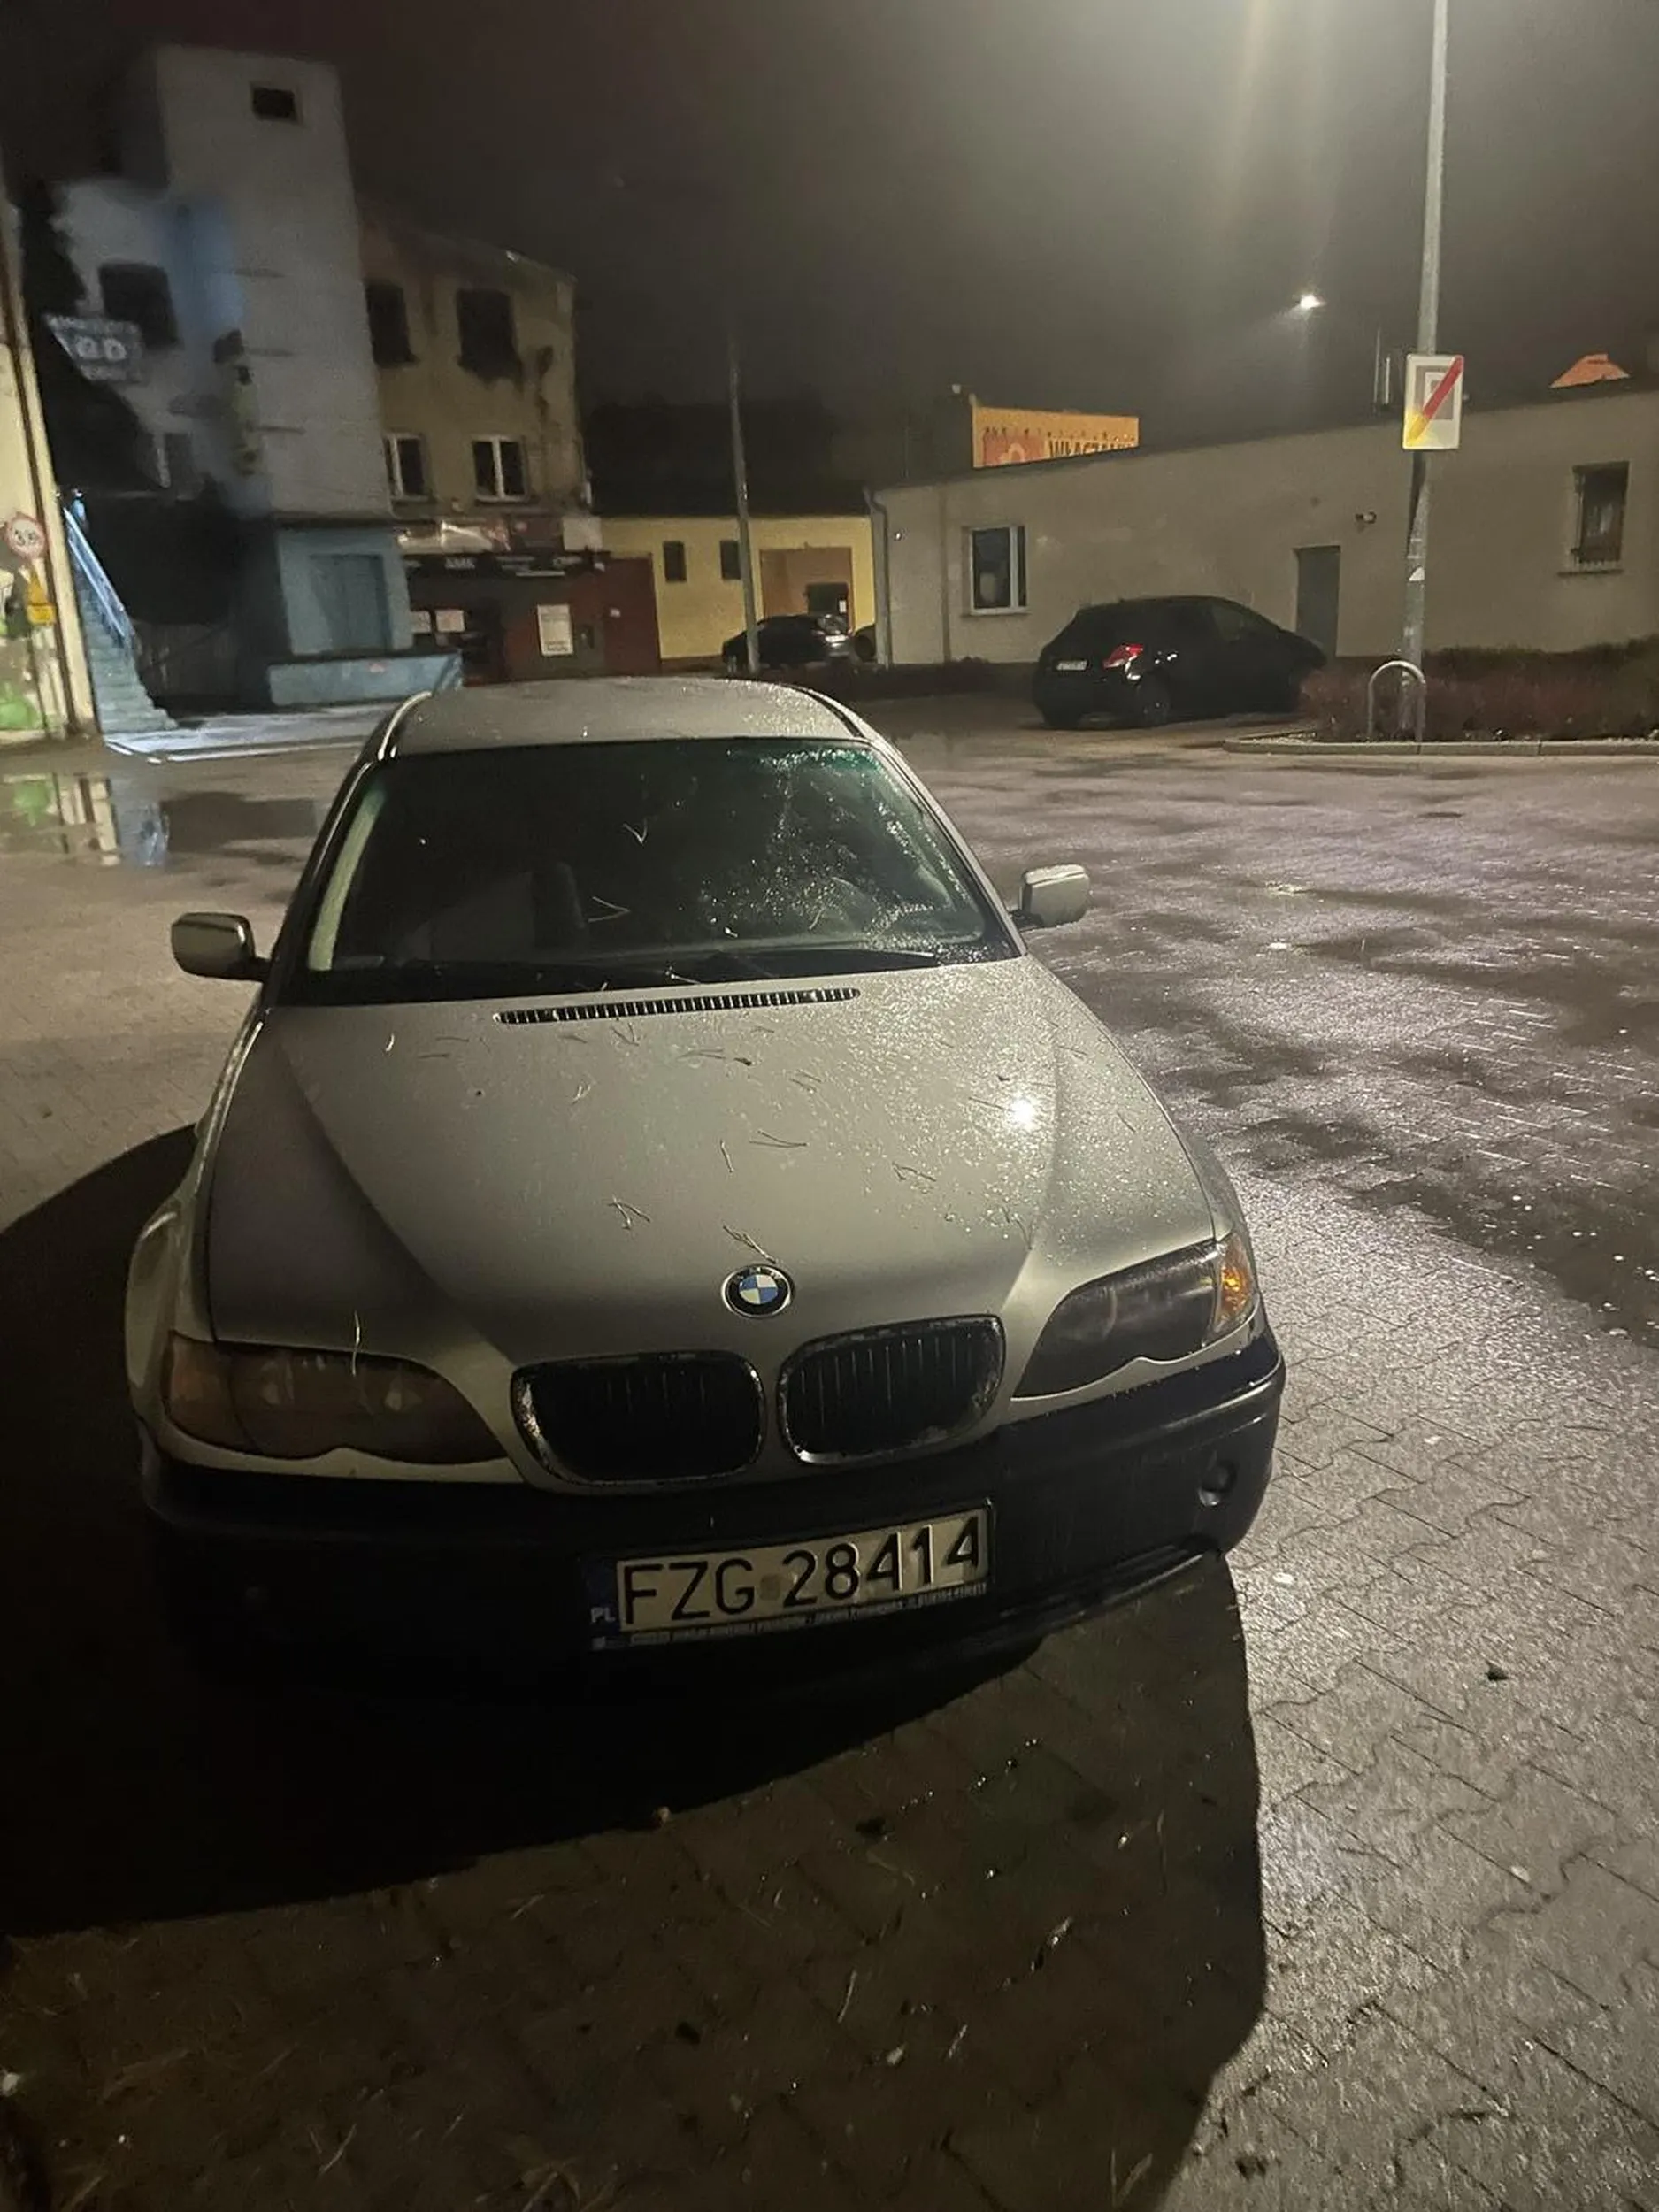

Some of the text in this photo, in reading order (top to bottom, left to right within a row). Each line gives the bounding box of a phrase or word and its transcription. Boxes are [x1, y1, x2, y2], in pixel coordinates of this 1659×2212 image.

[623, 1557, 756, 1624] FZG
[781, 1516, 980, 1608] 28414
[590, 1606, 617, 1623] PL
